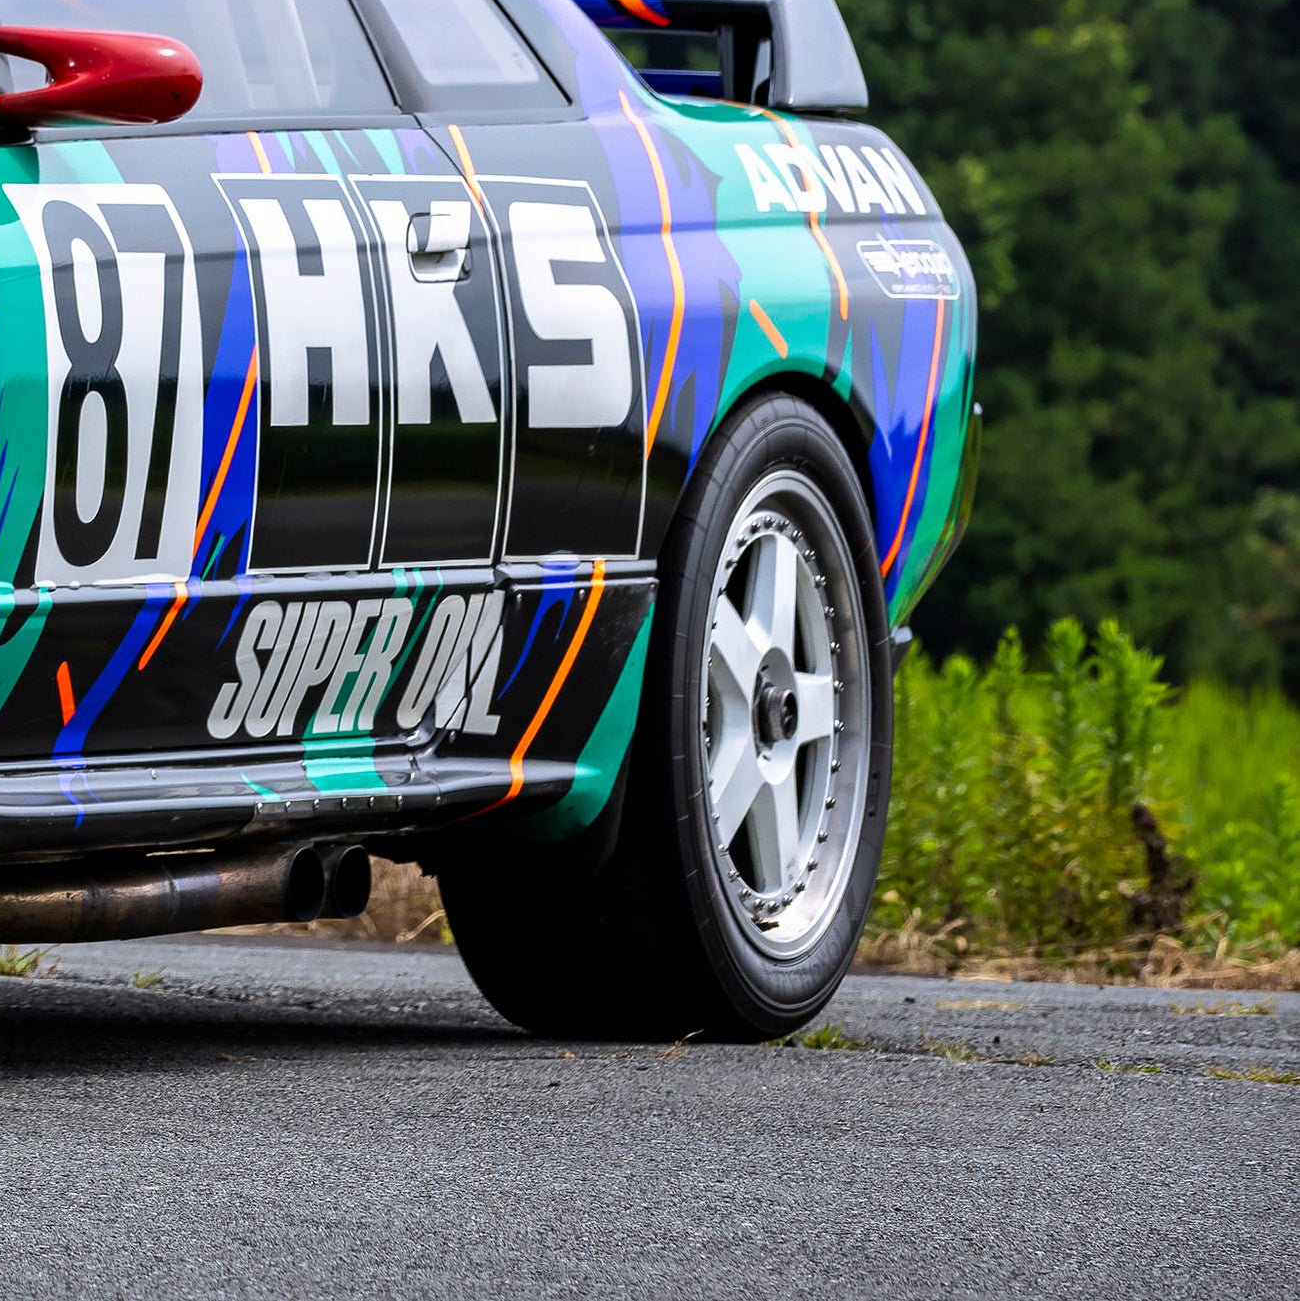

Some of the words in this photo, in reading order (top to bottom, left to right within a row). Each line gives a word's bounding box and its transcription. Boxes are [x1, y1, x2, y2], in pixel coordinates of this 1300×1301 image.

[734, 143, 926, 216] ADVAN
[39, 199, 174, 568] 87
[239, 197, 638, 429] HKS
[206, 598, 406, 741] SUPER
[399, 589, 506, 736] OIL
